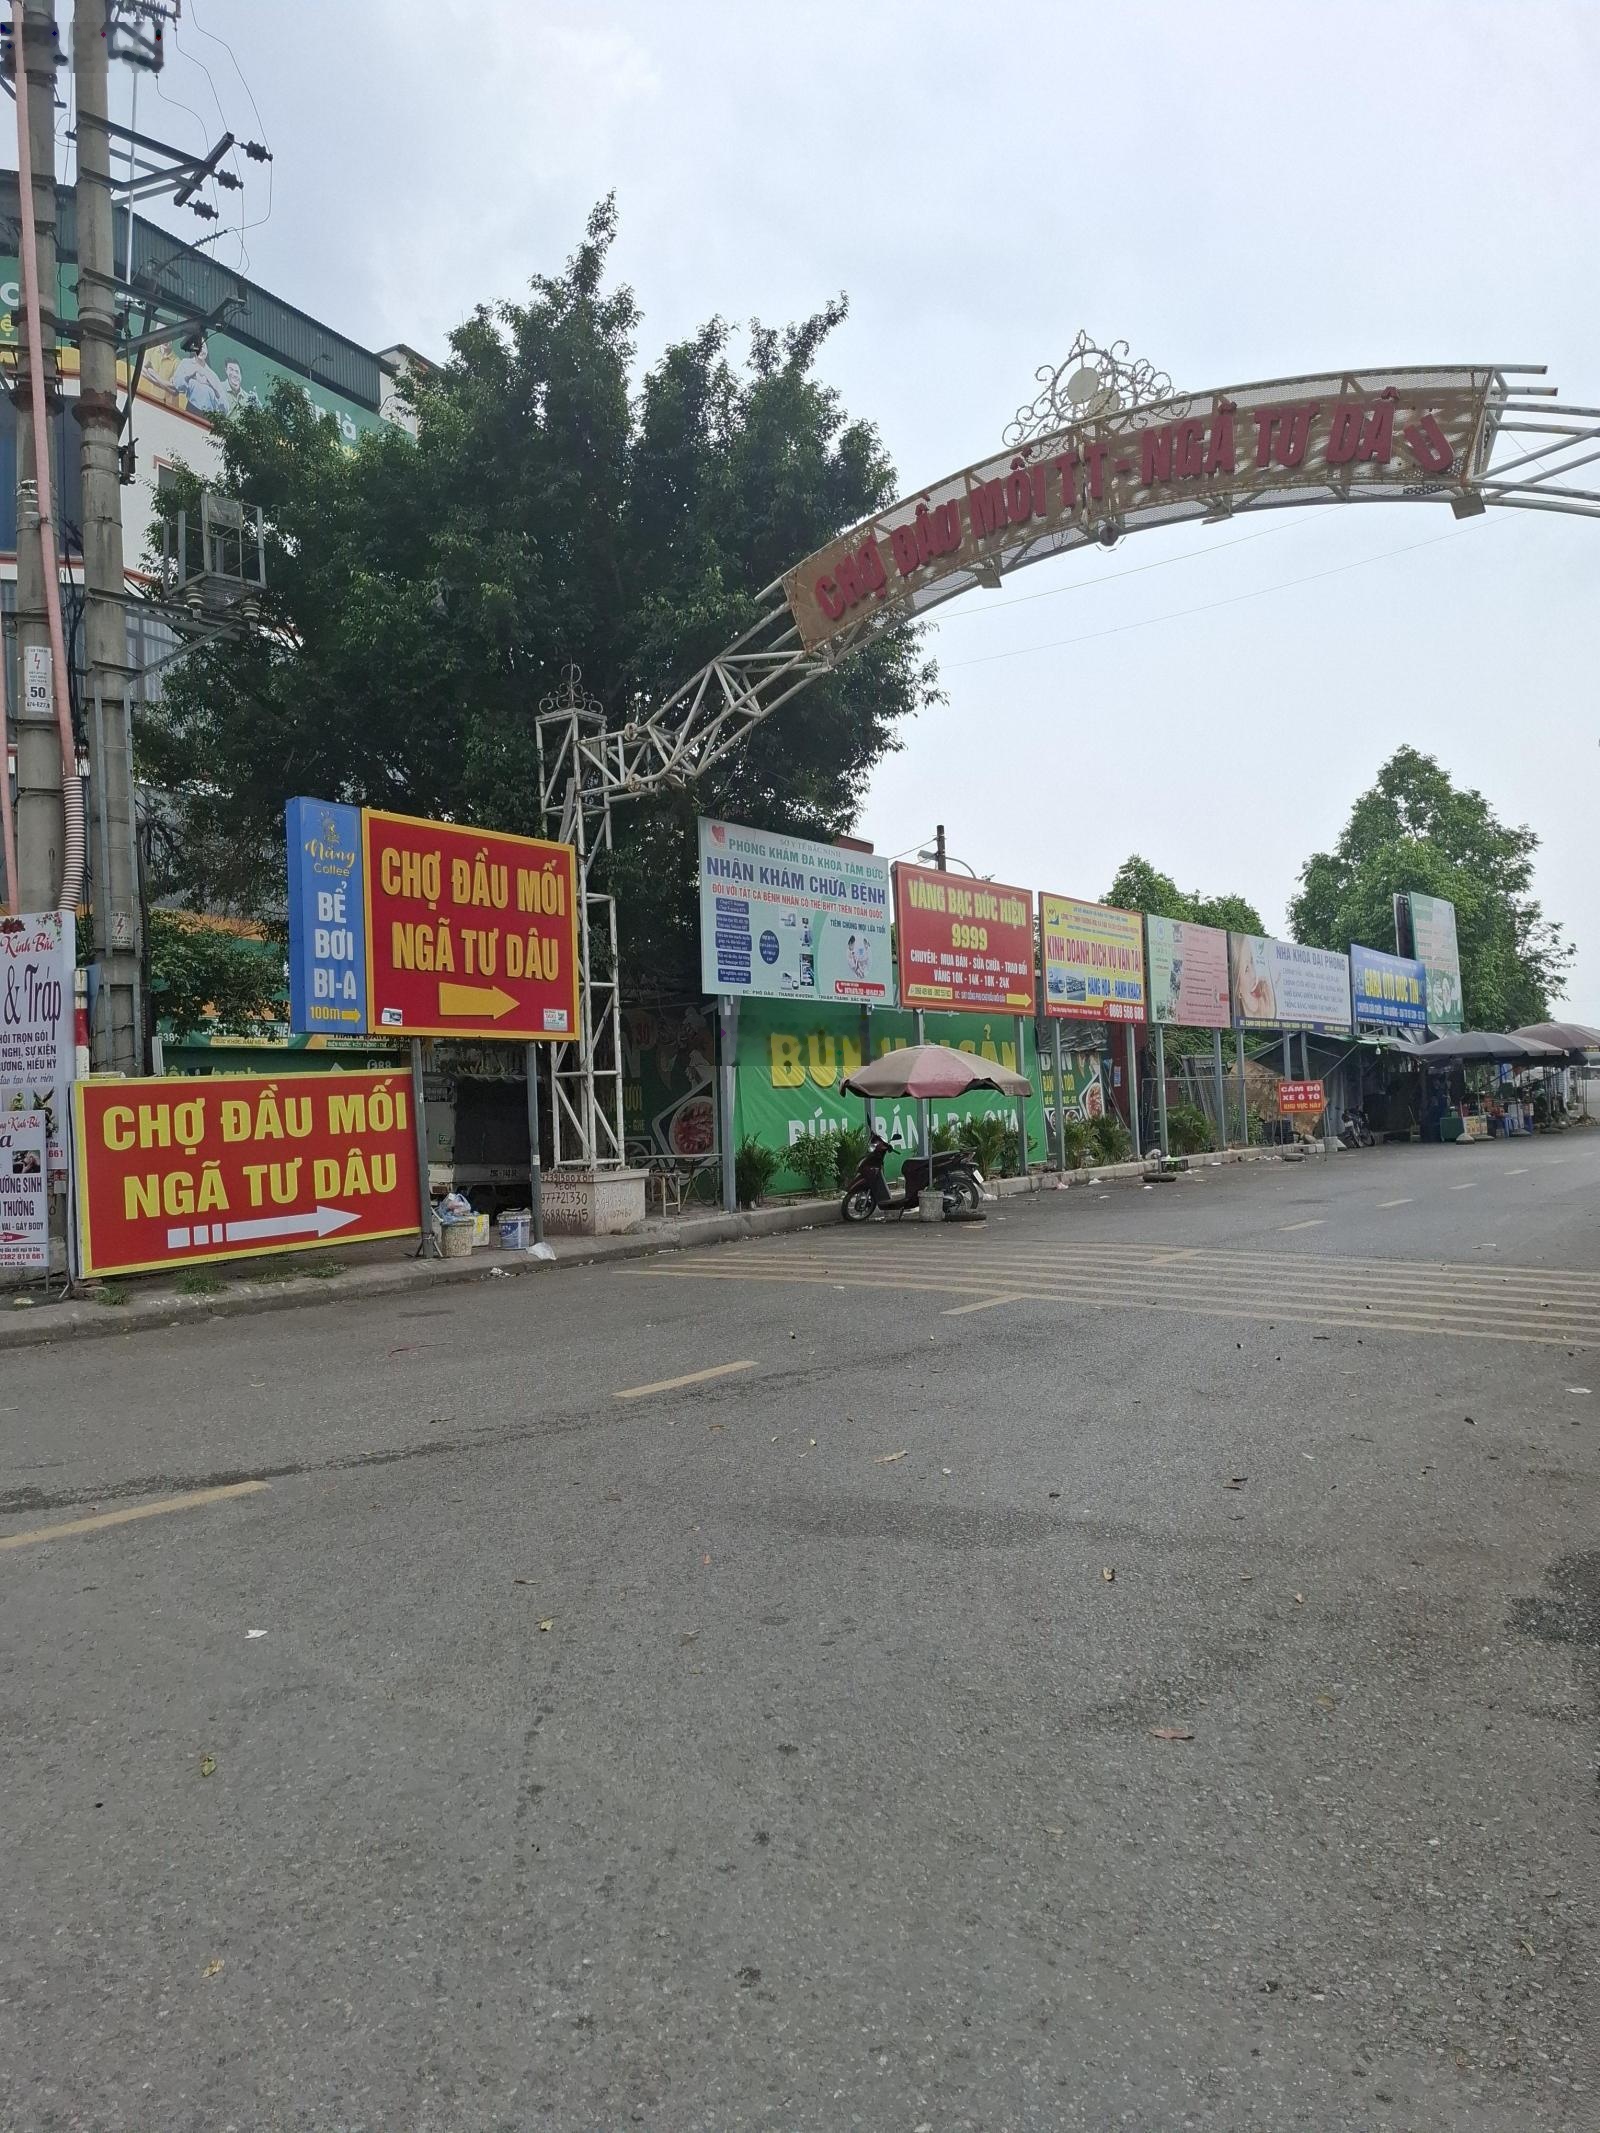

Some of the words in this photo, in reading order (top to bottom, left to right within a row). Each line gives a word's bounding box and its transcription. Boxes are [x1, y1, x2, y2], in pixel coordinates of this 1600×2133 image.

[890, 493, 962, 578] ĐẦU
[970, 446, 1048, 540] MỐI
[1253, 402, 1320, 468] TƯ
[1325, 385, 1454, 474] DÂU
[30, 686, 46, 698] 50
[313, 862, 350, 877] Coffee
[728, 838, 766, 857] PHÒNG
[769, 846, 799, 863] KHÁM
[801, 853, 815, 866] ĐA
[817, 857, 842, 871] KHOA
[845, 861, 864, 876] TÂM
[866, 865, 883, 880] ĐỨC
[381, 848, 441, 911] CHỢ
[451, 848, 509, 910] ĐẦU
[517, 859, 567, 916] MỐI
[706, 856, 754, 883] NHẬN
[759, 867, 804, 891] KHÁM
[809, 876, 847, 898] CHỮA
[851, 882, 886, 905] BỆNH
[318, 881, 347, 925] BỂ
[822, 900, 836, 912] BHYT
[838, 903, 852, 915] TRÊN
[908, 876, 946, 913] VÀNG
[947, 886, 972, 920] BẠC
[973, 889, 998, 922] ĐỨC
[315, 928, 354, 961] BƠI
[391, 917, 454, 973] NGÃ
[460, 927, 499, 977] TƯ
[505, 927, 559, 982] DÂU
[951, 923, 988, 952] 9999
[910, 948, 938, 964] CHUYÊN:
[940, 952, 955, 966] MUA
[955, 952, 968, 968] BÁN
[972, 954, 985, 970] SỬA
[1047, 935, 1065, 961] KINH
[1066, 938, 1089, 964] DOANH
[1091, 942, 1107, 971] DỊCH
[1107, 945, 1119, 974] VỤ
[1119, 944, 1131, 974] VẬN
[1292, 948, 1312, 966] KHOA
[313, 967, 357, 1000] BI-A
[933, 967, 951, 983] VÀNG
[4, 965, 21, 1025] &
[24, 963, 62, 1041] Tráp
[310, 1006, 341, 1022] 100m
[12, 1032, 33, 1045] TRỌN
[35, 1029, 48, 1042] GÓI
[25, 1044, 37, 1058] SỰ
[38, 1043, 56, 1057] KIỆN
[103, 1098, 205, 1155] CHỢ
[220, 1084, 313, 1143] ĐẦU
[328, 1078, 408, 1135] MỐI
[23, 1177, 42, 1193] SINH
[124, 1160, 230, 1220] NGÃ
[243, 1157, 302, 1207] TƯ
[313, 1148, 397, 1200] DÂU
[29, 1222, 44, 1231] BODY
